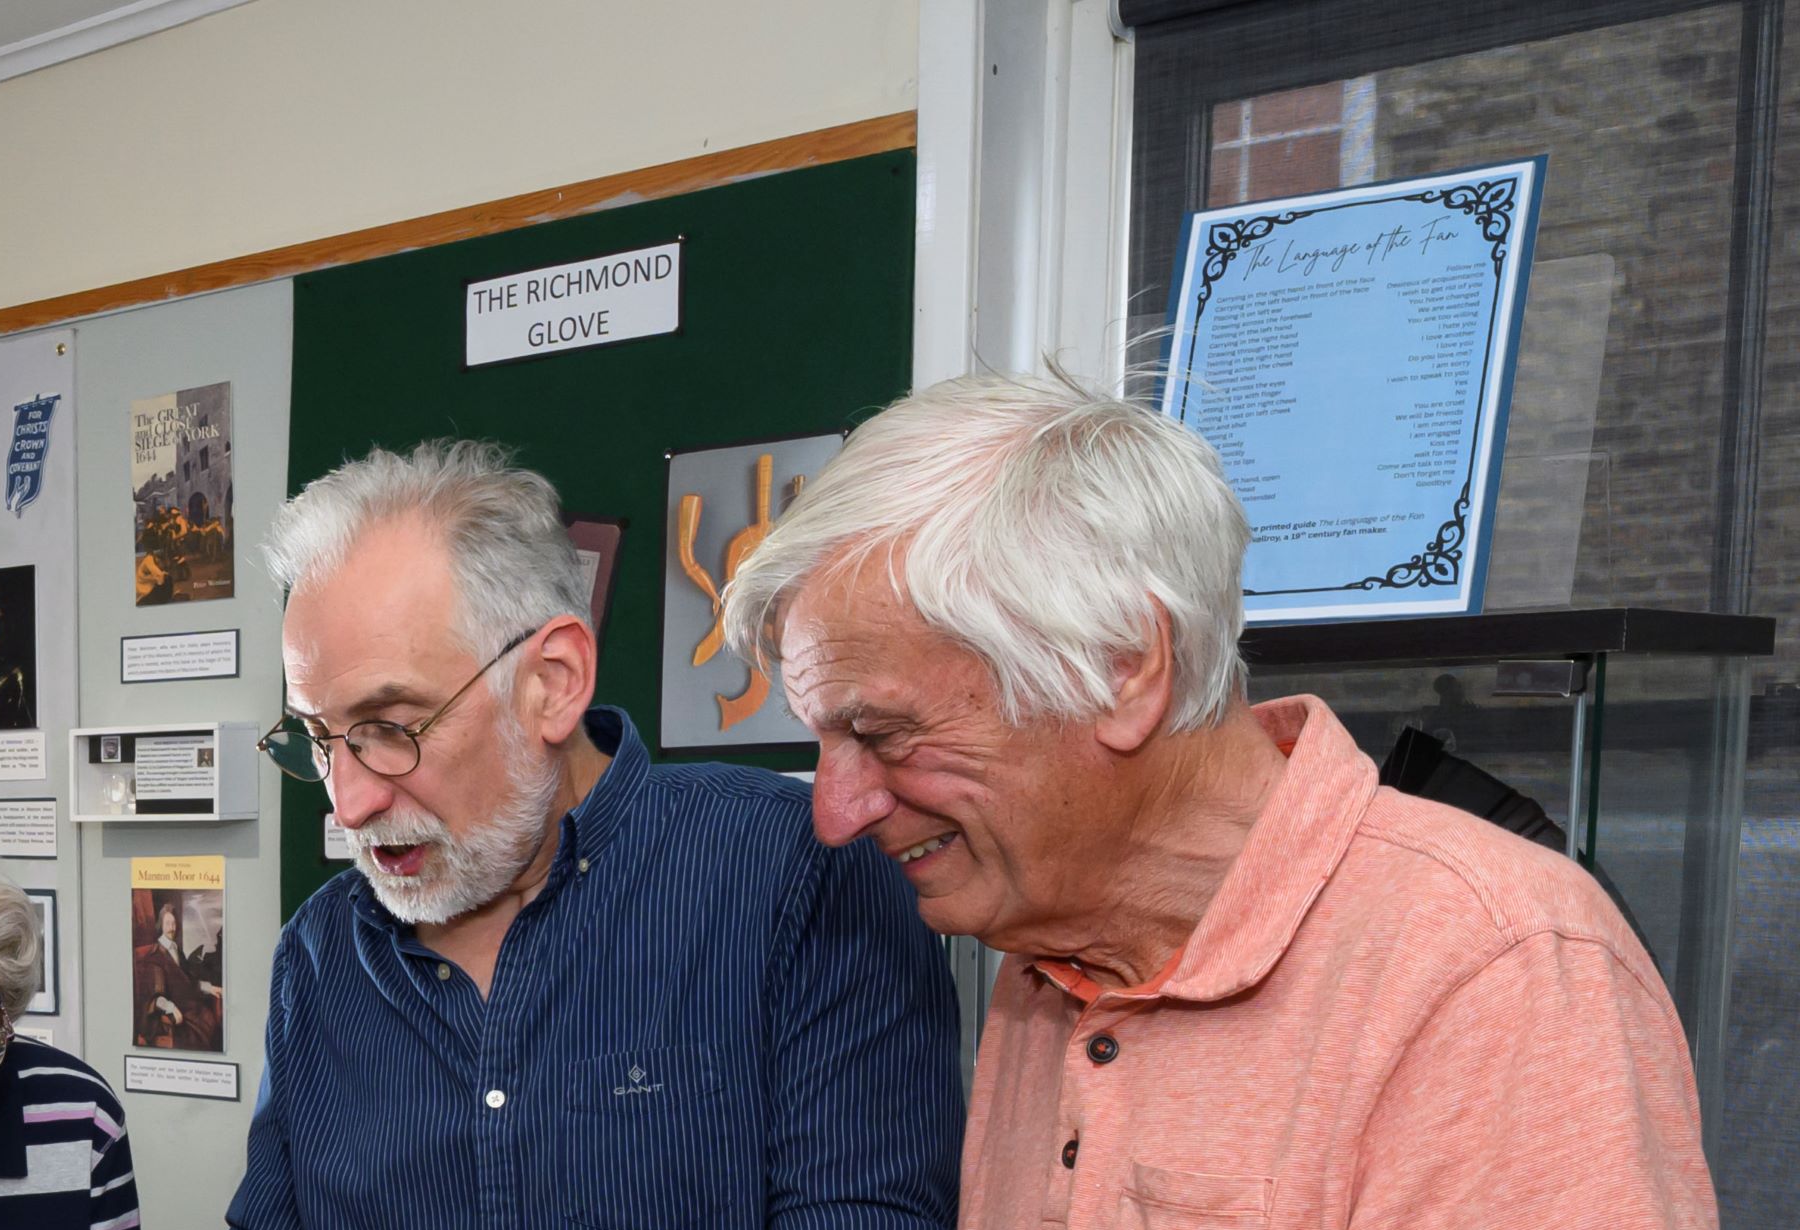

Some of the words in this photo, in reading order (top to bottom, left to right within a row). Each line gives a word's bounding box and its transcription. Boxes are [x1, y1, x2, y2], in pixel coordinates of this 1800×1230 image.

[1243, 238, 1277, 281] The
[1277, 239, 1361, 277] Language
[1365, 232, 1383, 265] of
[1381, 224, 1412, 262] the
[1419, 215, 1459, 255] Fan
[473, 283, 518, 315] THE
[527, 254, 672, 304] RICHMOND
[527, 310, 610, 347] GLOVE
[28, 411, 42, 420] FOR
[134, 414, 154, 427] The
[157, 402, 200, 421] GREAT
[16, 421, 49, 436] CHRISTS
[154, 417, 192, 436] CLOSE
[14, 439, 45, 452] CROWN
[135, 434, 171, 450] SIEGE
[184, 424, 220, 442] YORK
[21, 452, 36, 460] AND
[1260, 522, 1291, 533] printed
[1292, 520, 1317, 531] guide
[1319, 519, 1333, 527] The
[1335, 515, 1378, 526] Language
[1379, 514, 1390, 522] of
[1392, 513, 1406, 521] the
[1408, 512, 1425, 520] Fan
[1308, 528, 1341, 540] century
[1342, 528, 1357, 536] fan
[1359, 526, 1387, 535] maker.
[173, 870, 195, 881] Moor
[199, 872, 220, 884] 1644
[613, 1083, 664, 1095] GANT
